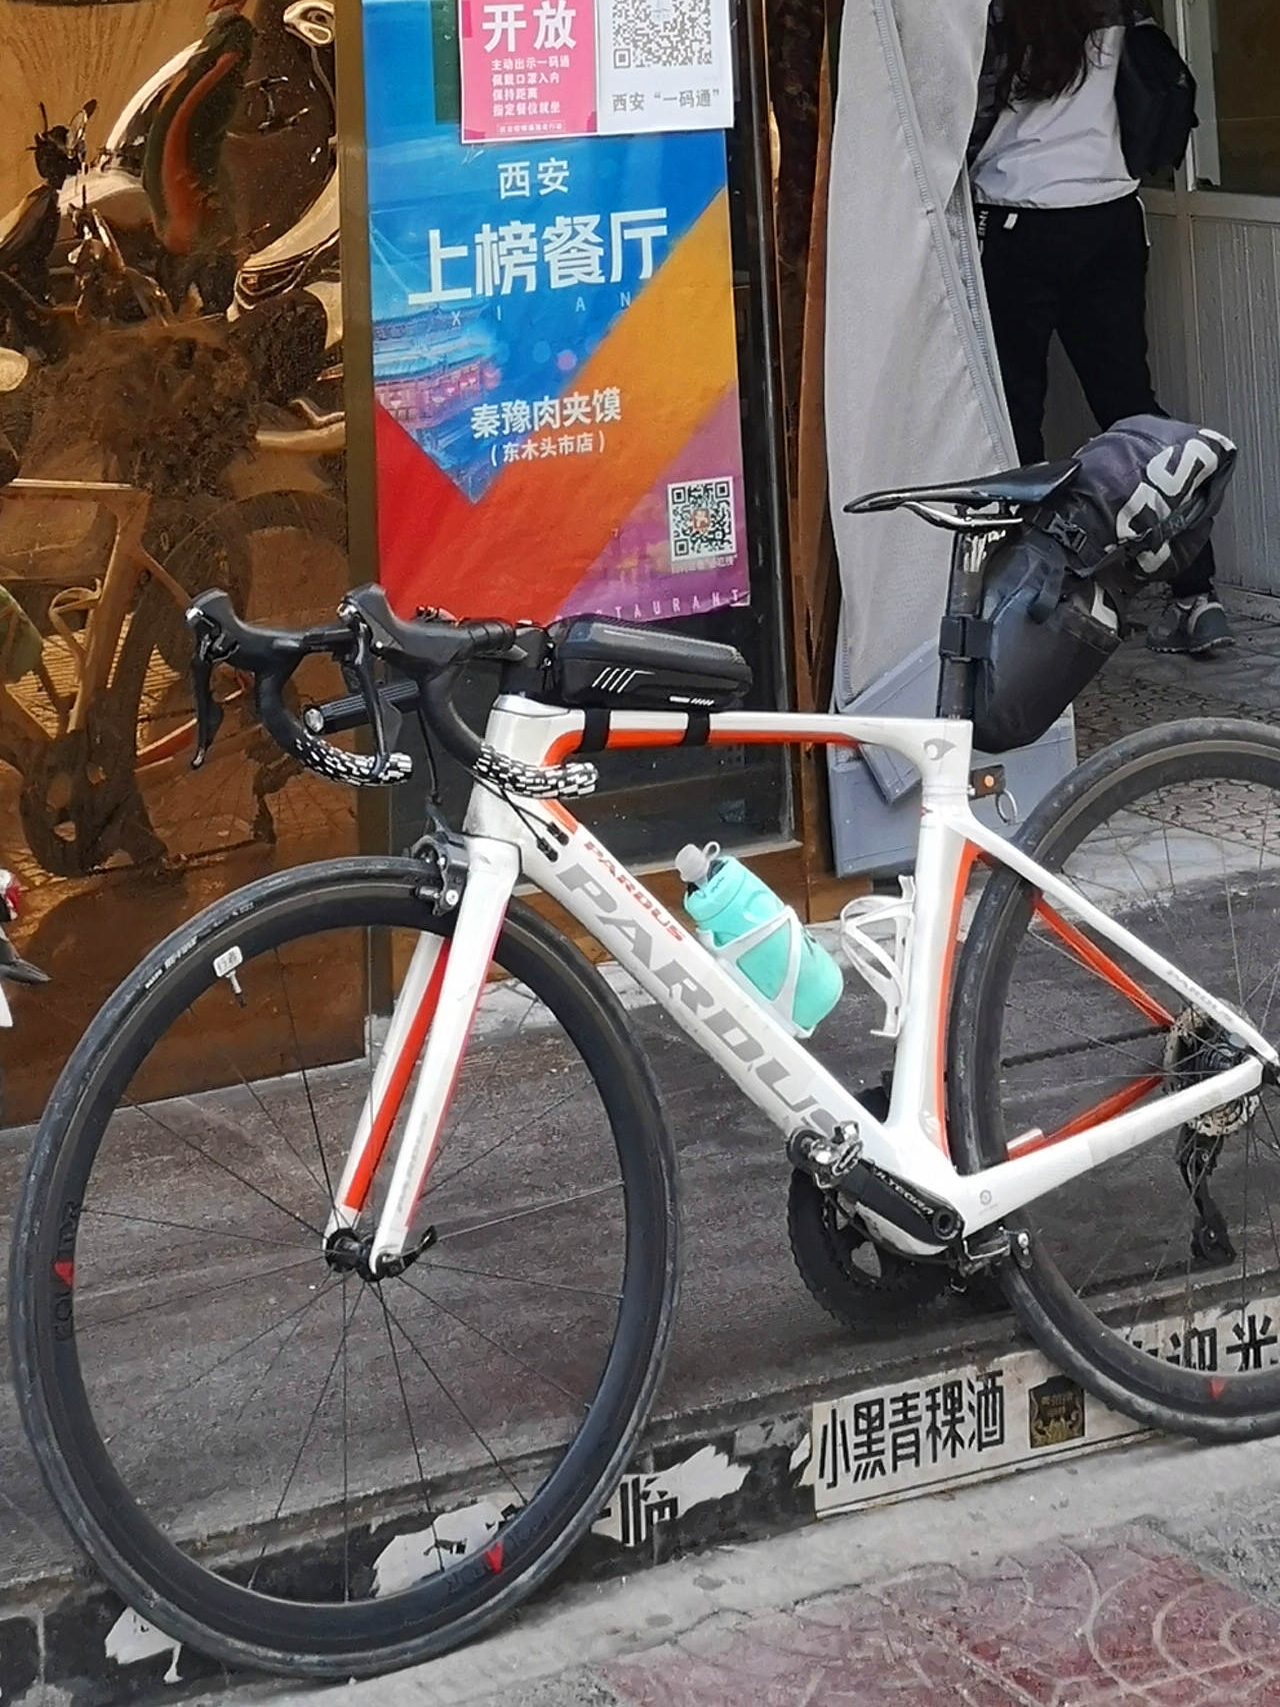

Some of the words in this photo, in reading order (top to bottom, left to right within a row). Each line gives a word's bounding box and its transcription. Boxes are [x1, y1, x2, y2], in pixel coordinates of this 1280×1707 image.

[481, 0, 577, 53] 开放
[491, 55, 571, 72] 主动出示一码通
[492, 87, 539, 102] 保持距离
[497, 157, 570, 200] 西安
[408, 207, 668, 305] 上榜餐厅
[471, 386, 622, 439] 秦豫肉夹馍
[583, 840, 683, 942] PARDUS
[819, 1369, 1006, 1489] 小黑青稞酒
